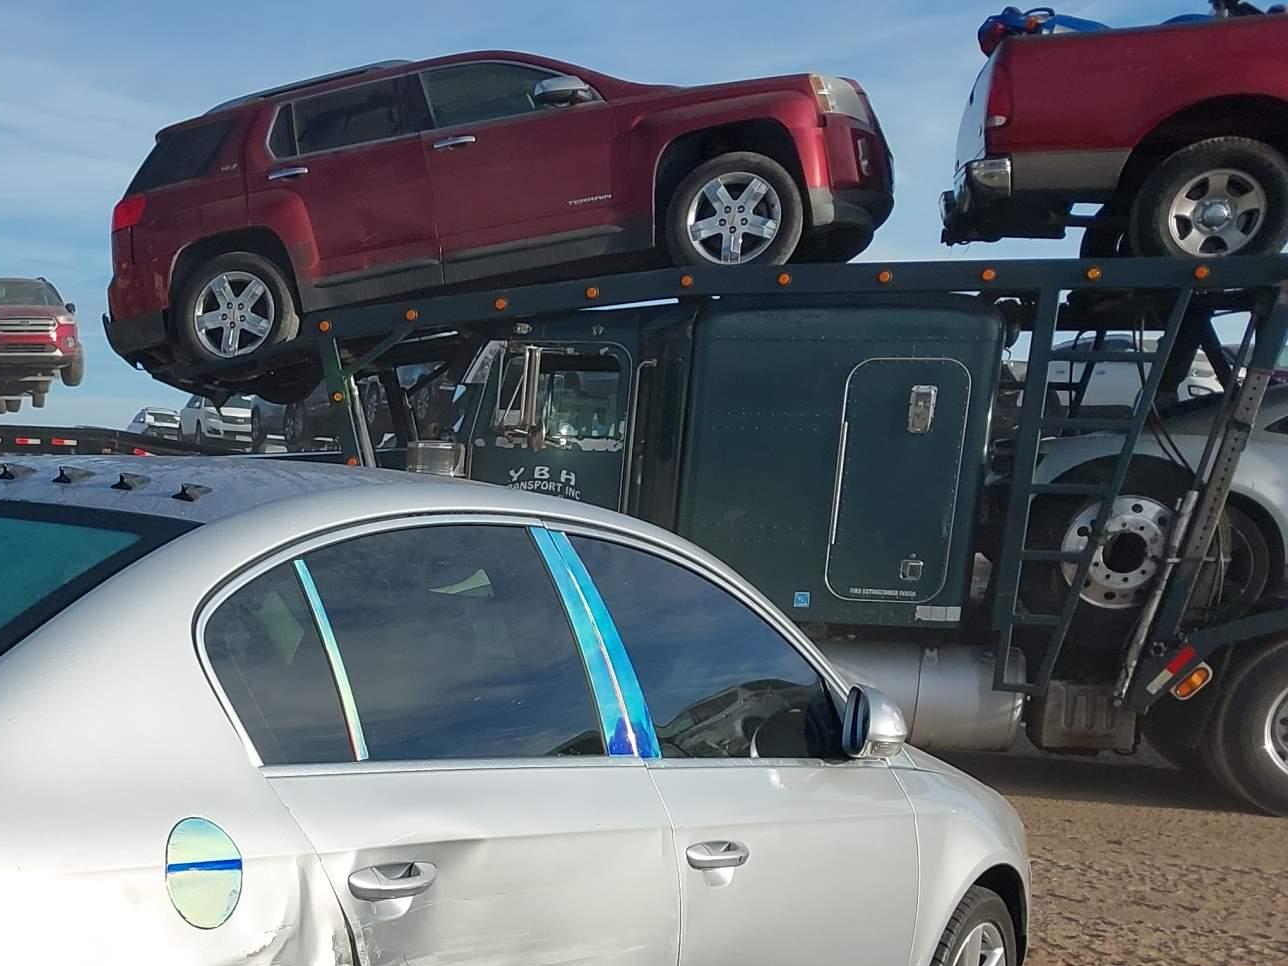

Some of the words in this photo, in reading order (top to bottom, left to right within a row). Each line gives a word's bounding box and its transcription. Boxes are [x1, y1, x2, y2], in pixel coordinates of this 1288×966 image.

[568, 193, 612, 206] TERRAIN
[507, 480, 563, 492] RANSPORT
[566, 486, 581, 500] INC
